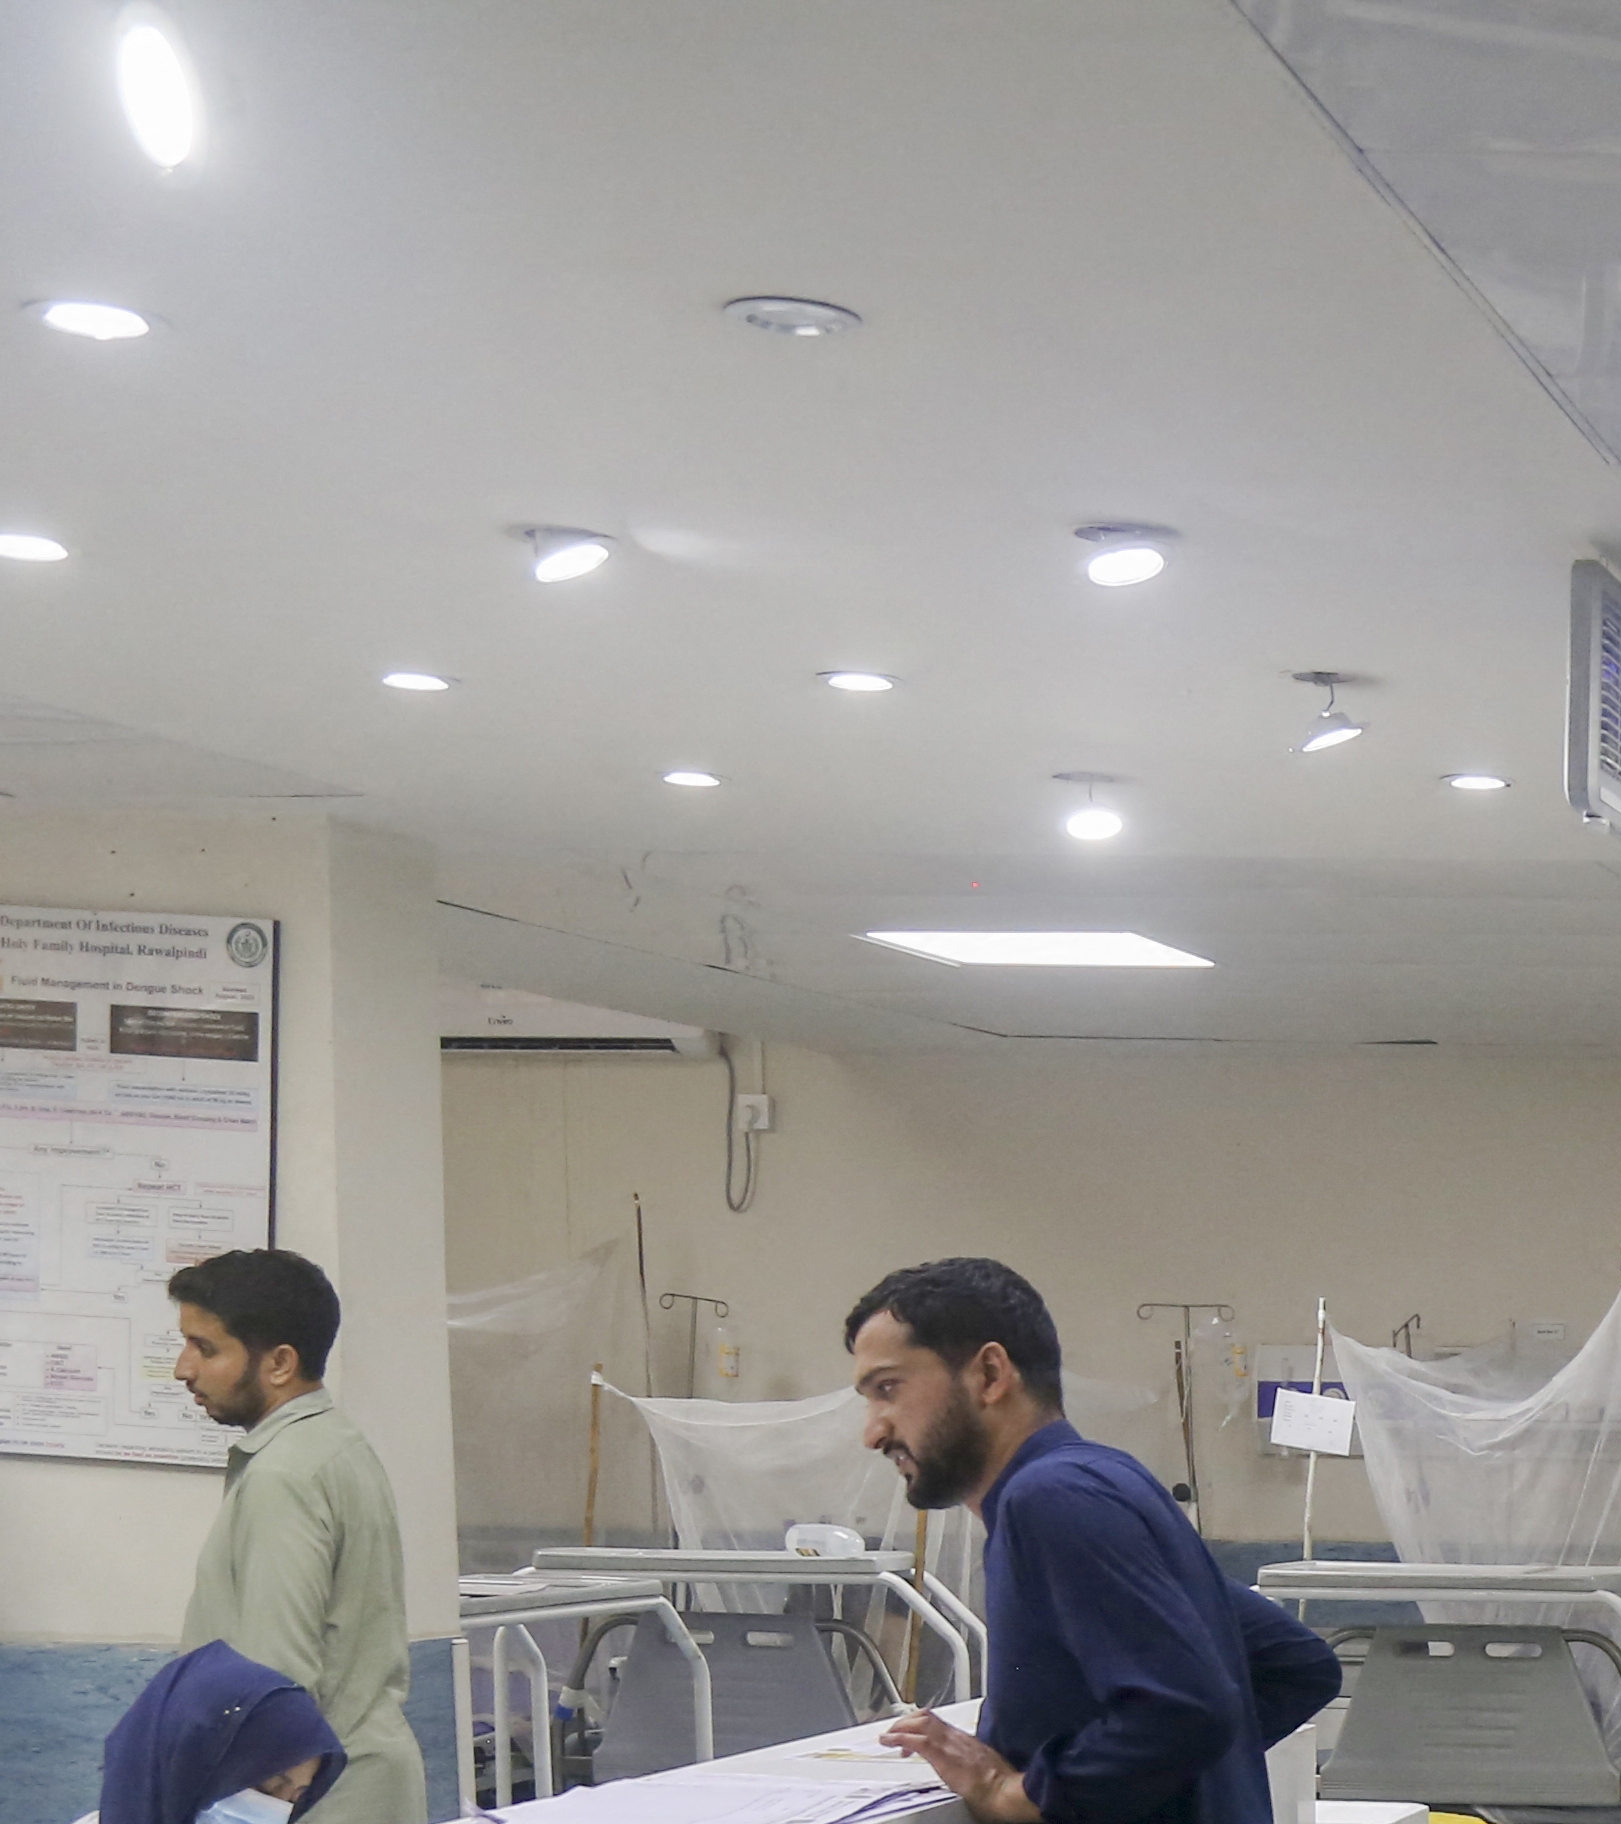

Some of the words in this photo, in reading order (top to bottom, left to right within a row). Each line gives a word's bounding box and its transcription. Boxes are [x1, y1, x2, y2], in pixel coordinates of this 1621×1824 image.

[0, 915, 72, 931] Department
[76, 919, 92, 931] Of
[96, 920, 156, 935] Infectious
[159, 923, 209, 938] Diseases
[1, 937, 28, 950] Holy
[33, 939, 73, 954] Family
[137, 944, 208, 960] Rawalpindi
[41, 977, 110, 992] Management
[112, 980, 123, 991] in
[126, 982, 168, 996] Dengue
[171, 984, 204, 996] Shock
